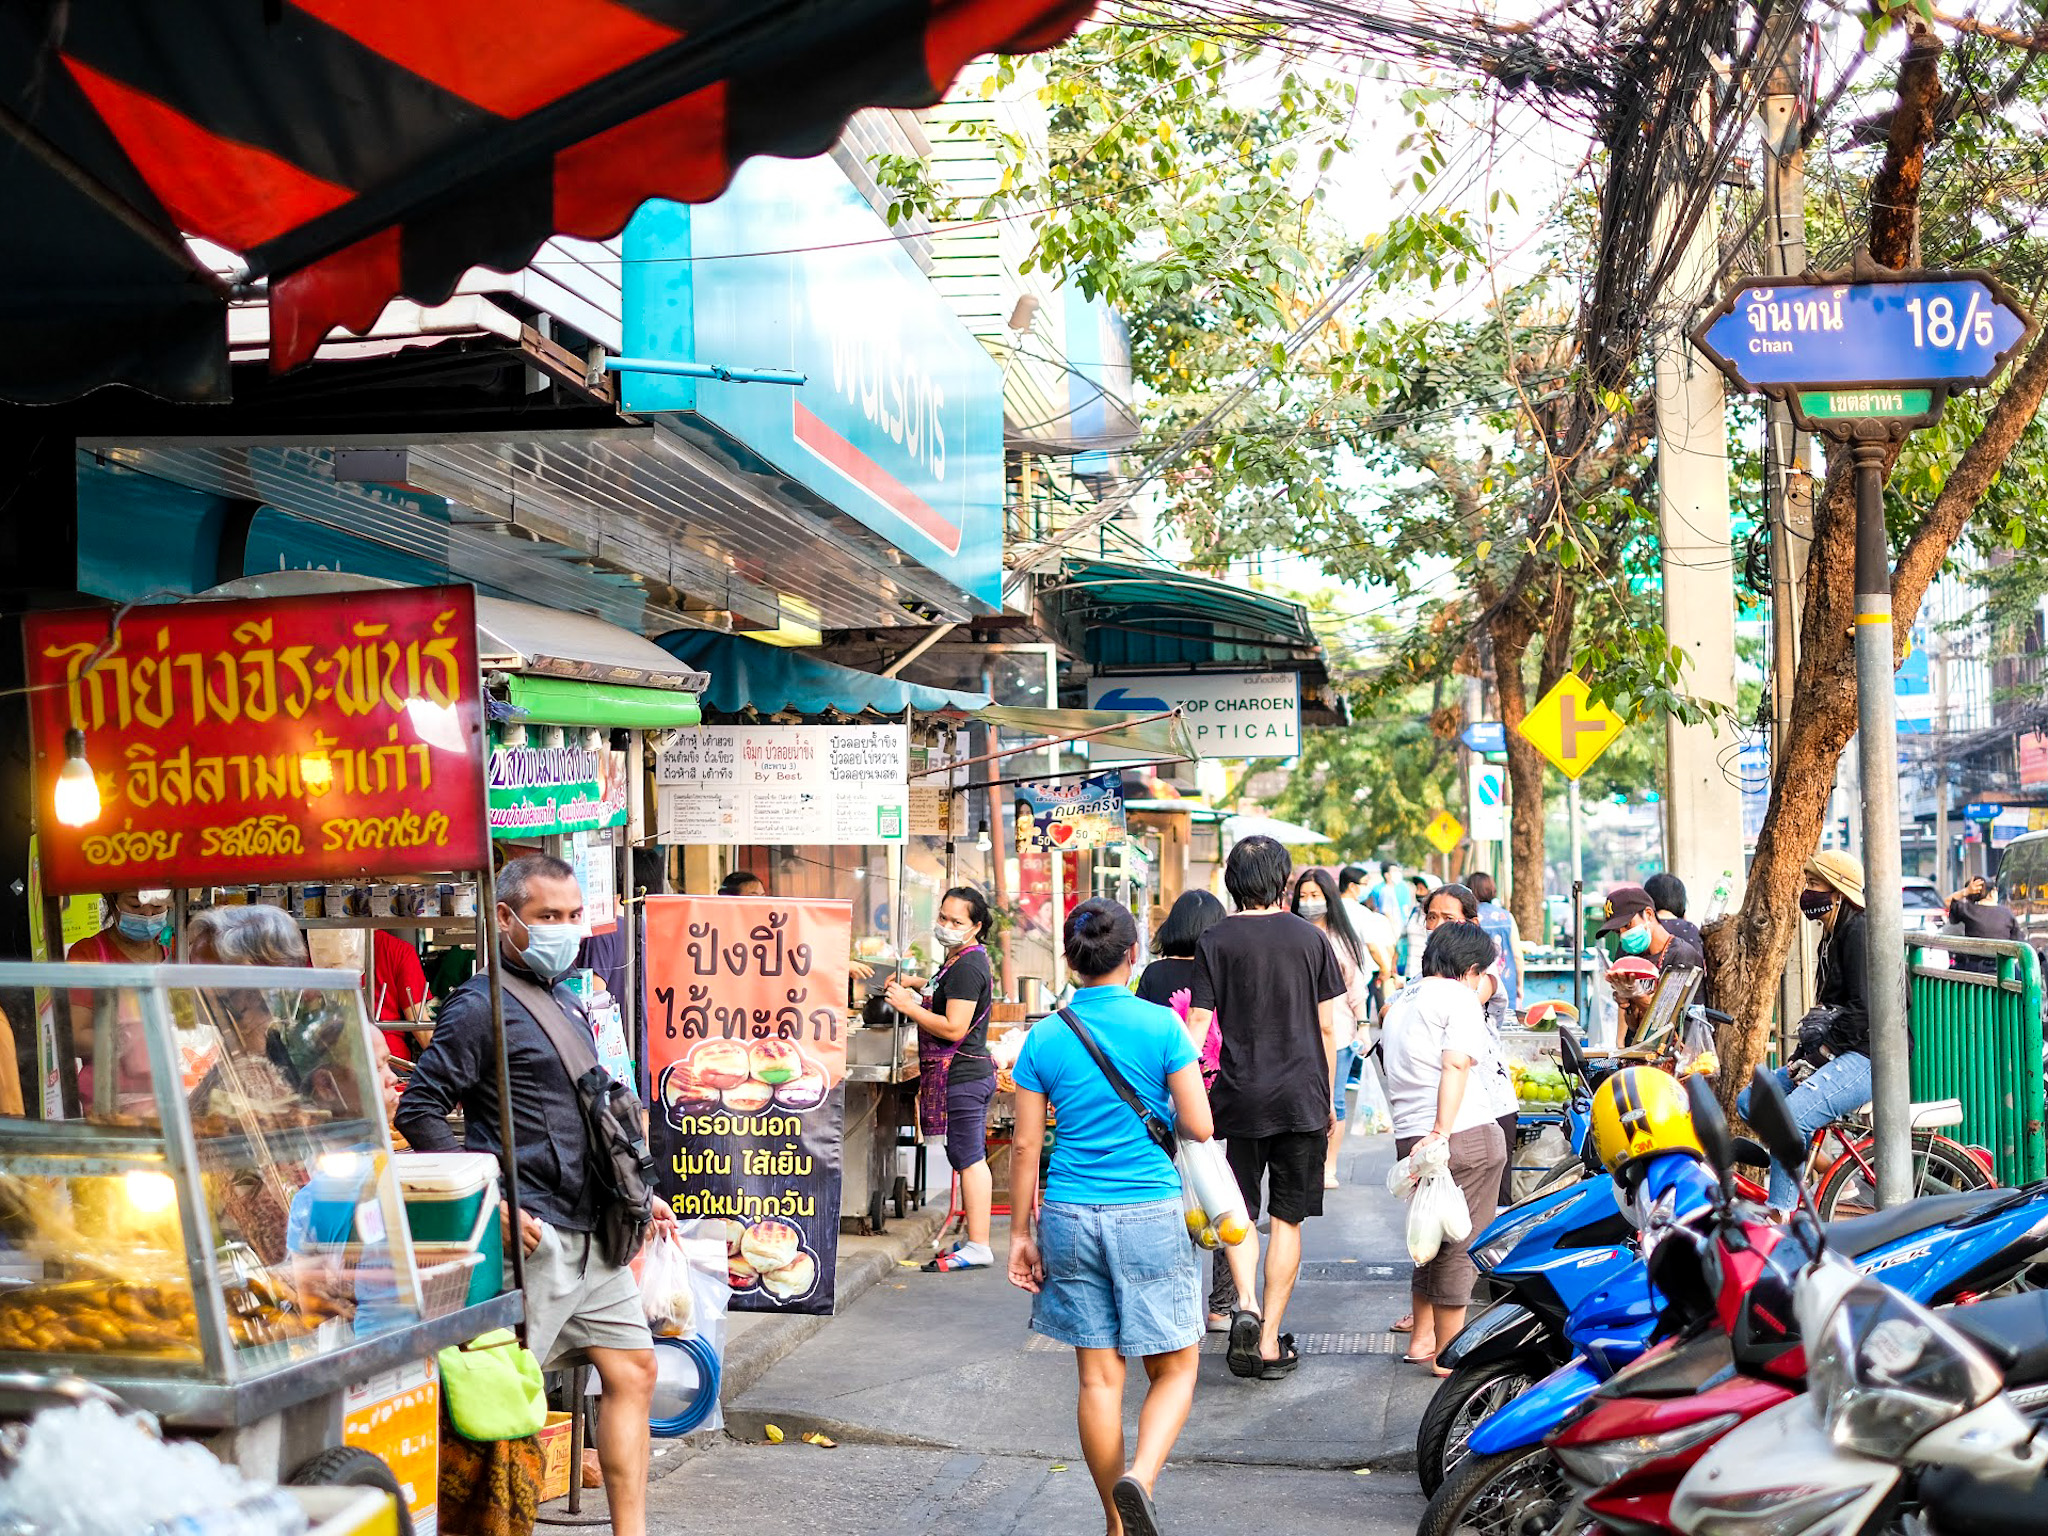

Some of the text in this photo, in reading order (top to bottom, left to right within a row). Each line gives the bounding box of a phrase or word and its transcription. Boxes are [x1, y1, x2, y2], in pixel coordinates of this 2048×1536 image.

[1747, 289, 1994, 351] จันทน์ 18/5
[1749, 338, 1793, 353] Chan
[1829, 392, 1904, 413] เขตสาทร
[43, 608, 463, 732] ไก่ย่างจีระพันธ์
[1214, 697, 1295, 712] CHAROEN
[830, 731, 897, 749] บัวลอยน้ำขิง
[1195, 722, 1295, 740] PTICAL
[765, 732, 815, 760] บัวลอยน้ำขิง
[830, 749, 899, 765] บัวลอยไข่หวาน
[754, 771, 803, 782] By Best
[830, 767, 898, 781] บัวลอยนมสด
[1055, 789, 1121, 817] คนละครึ่ง
[82, 817, 182, 866] อร่อย
[201, 814, 305, 857] รสเด็ด
[321, 808, 450, 852] ราคาเยา
[1037, 835, 1051, 846] 50
[1075, 829, 1088, 839] 50
[687, 911, 813, 977] ปังปิ้ง
[655, 984, 838, 1042] ไส้ทะลัก
[681, 1114, 801, 1136] กรอบนอก
[1633, 1138, 1654, 1154] 3M
[672, 1143, 813, 1182] นุ่มใน ไส้เยิ้ม
[672, 1188, 815, 1223] สดใหม่ทุกวัน
